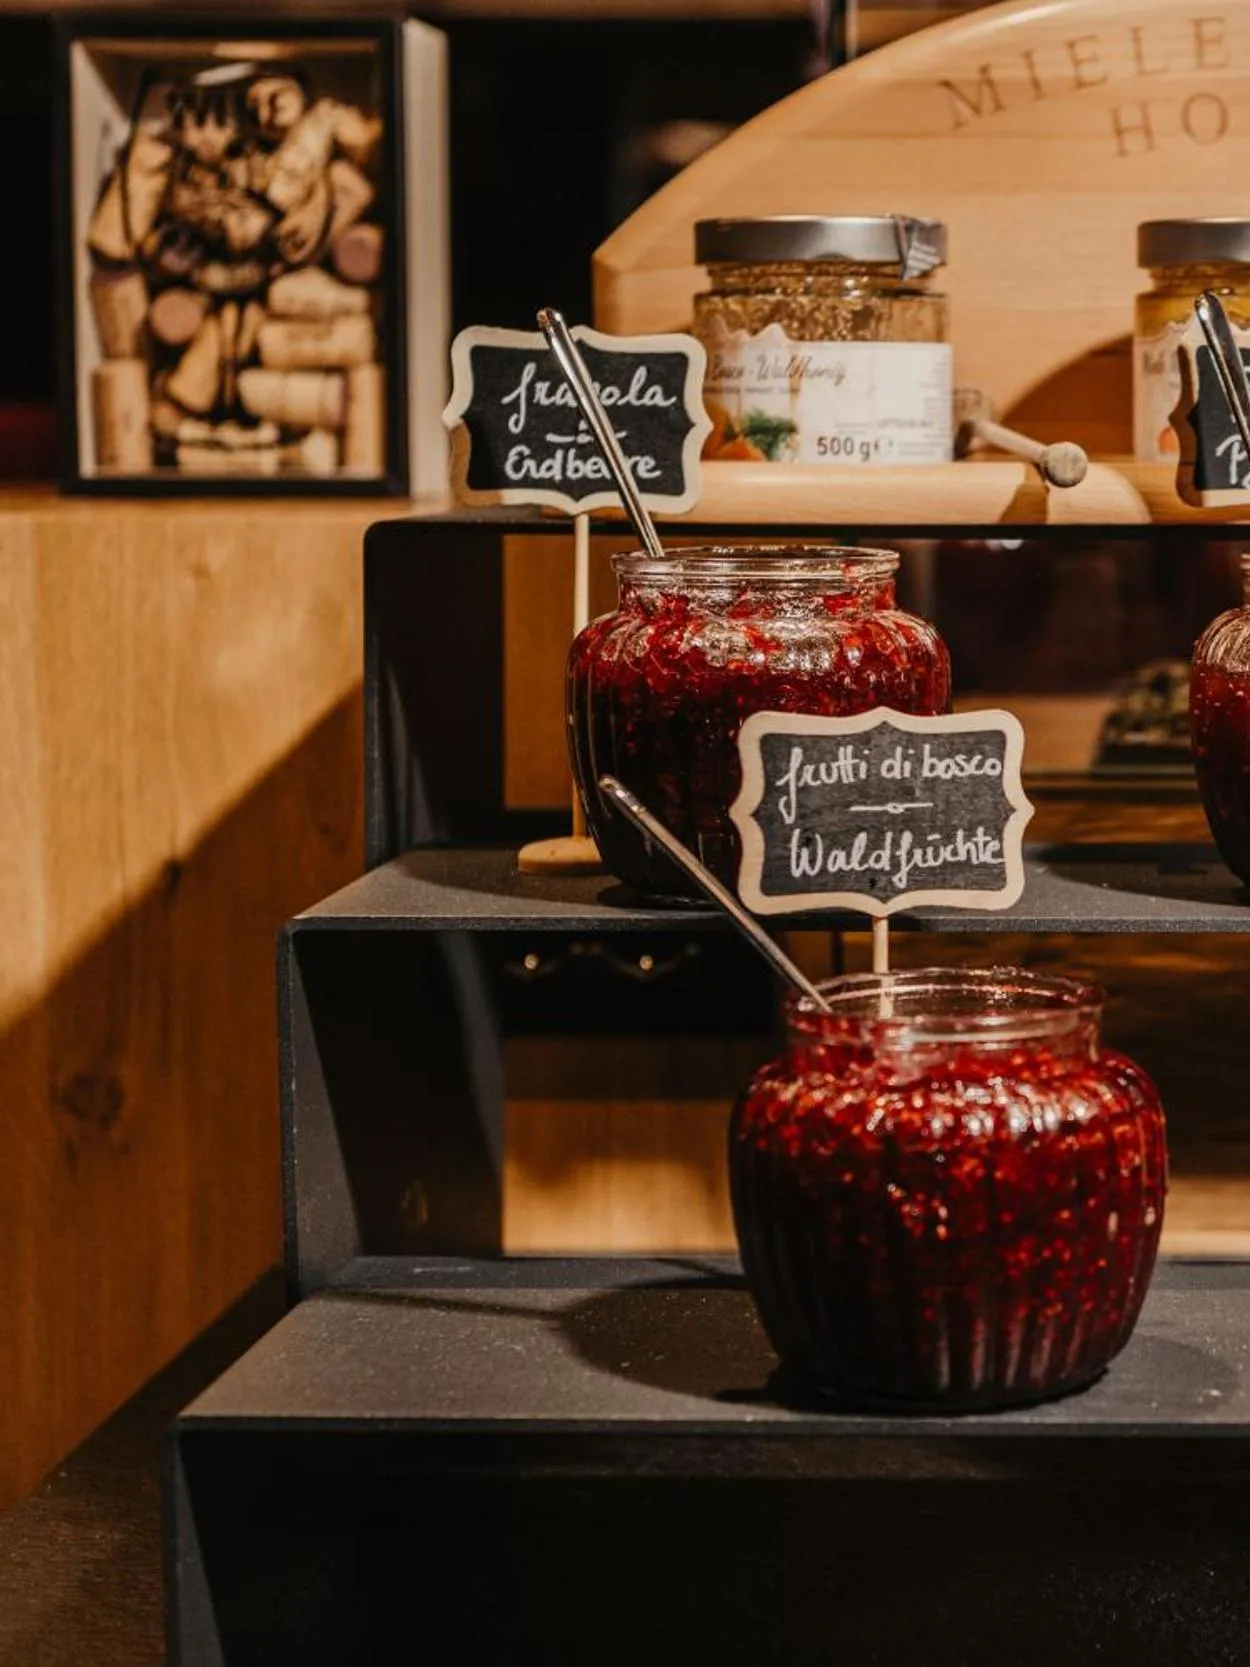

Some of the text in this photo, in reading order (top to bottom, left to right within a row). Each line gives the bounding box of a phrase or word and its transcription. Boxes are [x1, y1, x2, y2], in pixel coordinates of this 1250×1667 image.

[501, 361, 678, 435] fraola
[504, 444, 663, 482] Erdbere
[816, 435, 854, 457] 500
[775, 743, 1002, 825] frutti di bosco
